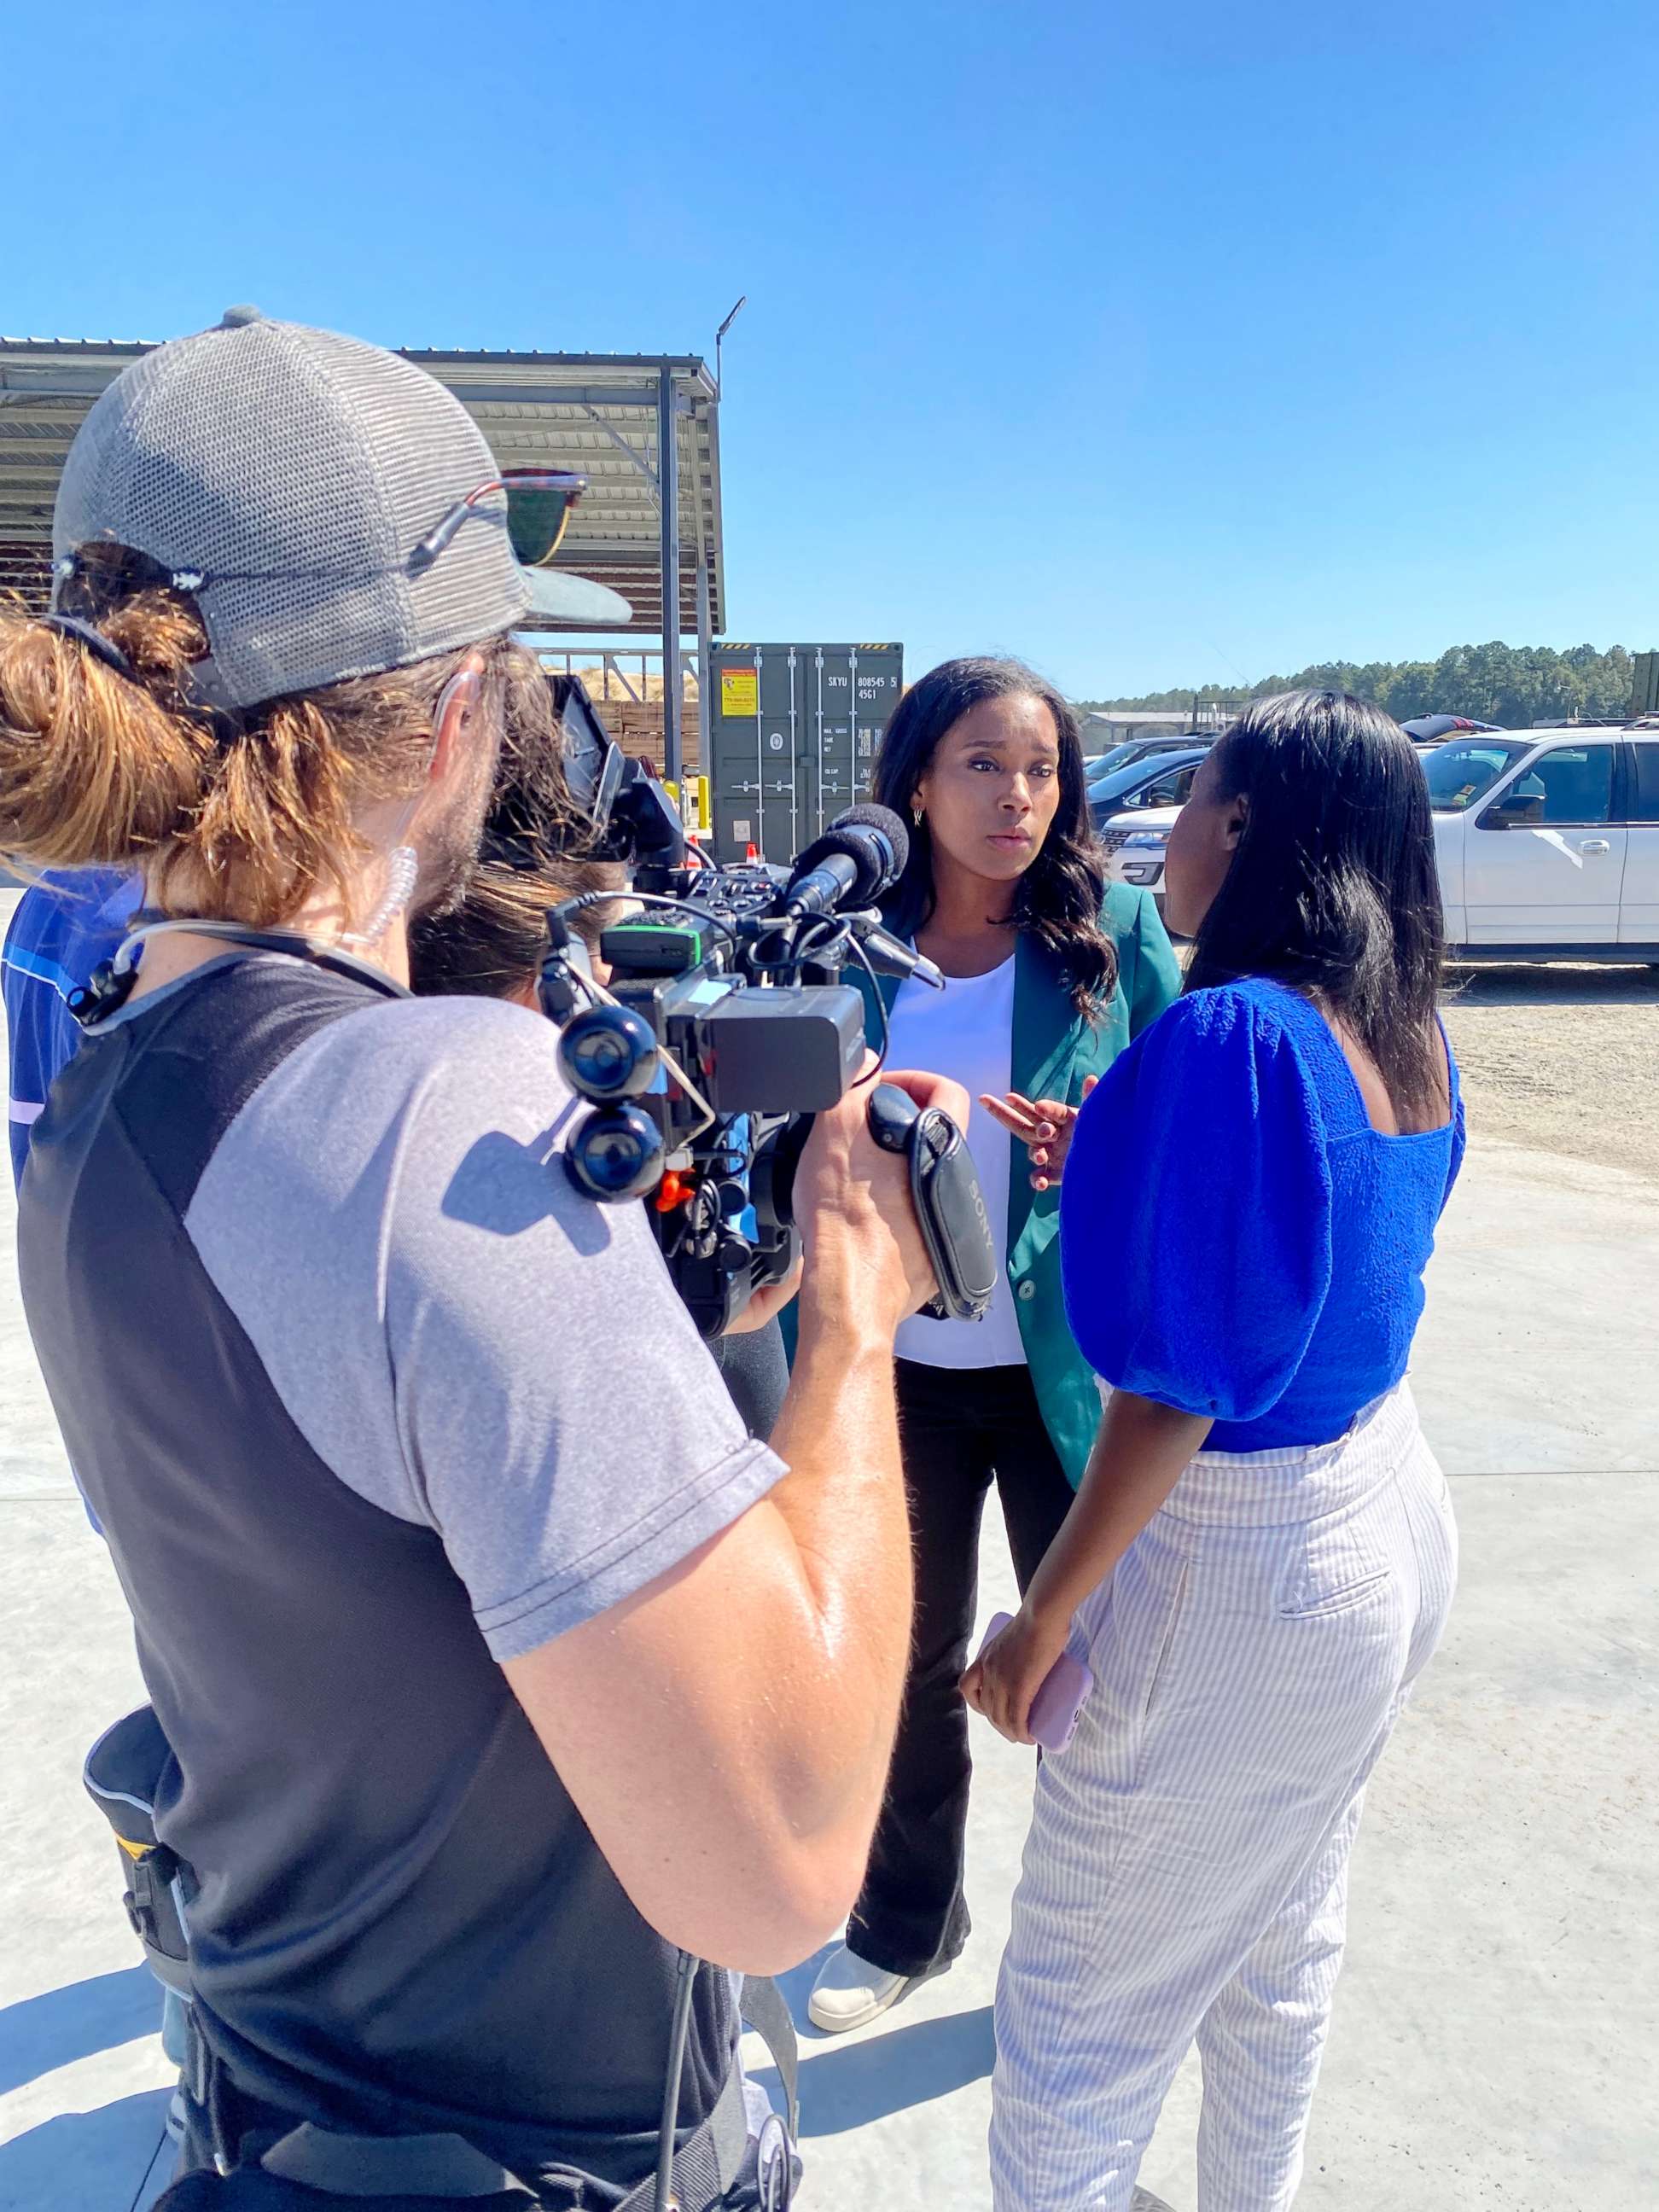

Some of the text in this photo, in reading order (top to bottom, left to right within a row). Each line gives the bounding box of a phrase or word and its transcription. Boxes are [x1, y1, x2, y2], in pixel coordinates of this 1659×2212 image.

[828, 676, 847, 687] SKYU
[858, 677, 885, 687] 808545
[859, 690, 876, 699] 45G1
[969, 1179, 993, 1249] SONY
